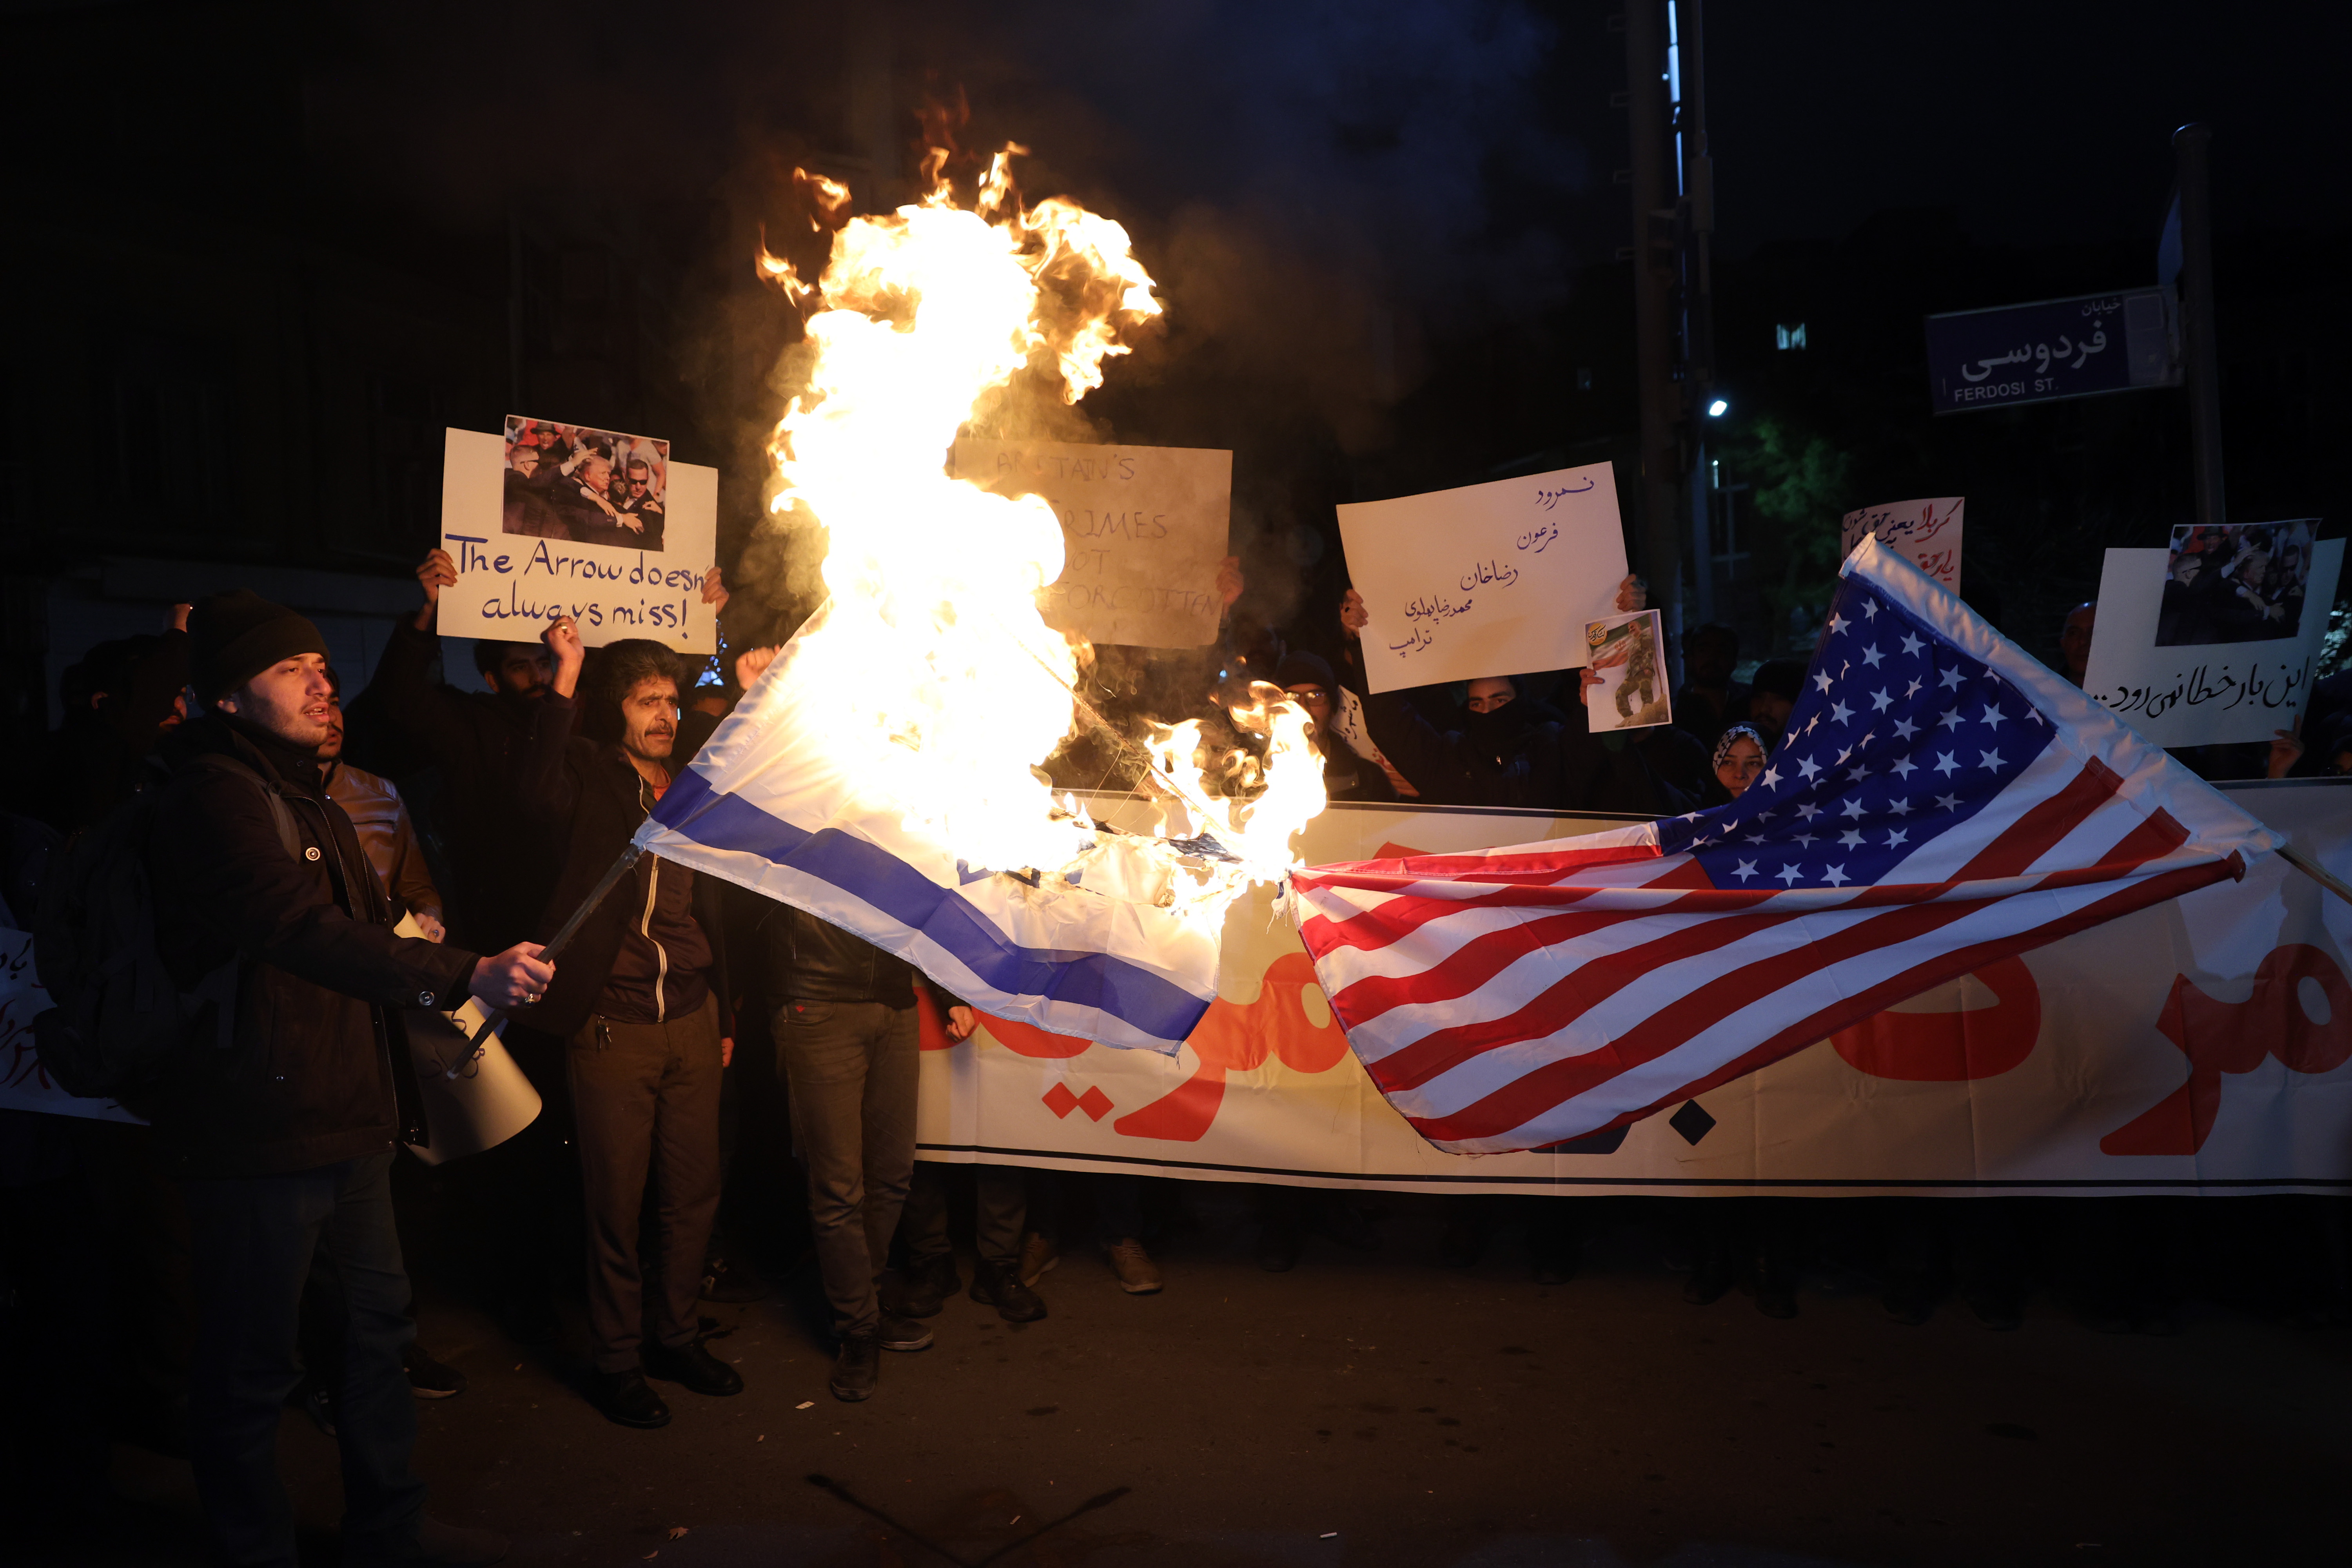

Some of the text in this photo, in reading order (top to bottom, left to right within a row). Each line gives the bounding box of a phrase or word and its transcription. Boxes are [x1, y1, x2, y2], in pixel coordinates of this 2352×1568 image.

[2081, 297, 2122, 317] خیابان
[1962, 319, 2107, 382] فردوسی
[1954, 377, 2059, 402] FERDOSI ST.
[1535, 476, 1595, 512] نمرود
[1051, 499, 1168, 541] RIMES
[1517, 523, 1559, 553] فرعون
[1875, 519, 1915, 542] یعنی
[1915, 499, 1963, 543] کربلا
[445, 534, 513, 574] The
[524, 539, 622, 581] Arrow
[482, 579, 688, 640] always miss!
[1056, 581, 1224, 617] ORGOTTEN
[1389, 627, 1433, 658] ترامپ
[2187, 665, 2236, 704] خطا
[2223, 663, 2263, 710] بار
[2263, 655, 2310, 708] این
